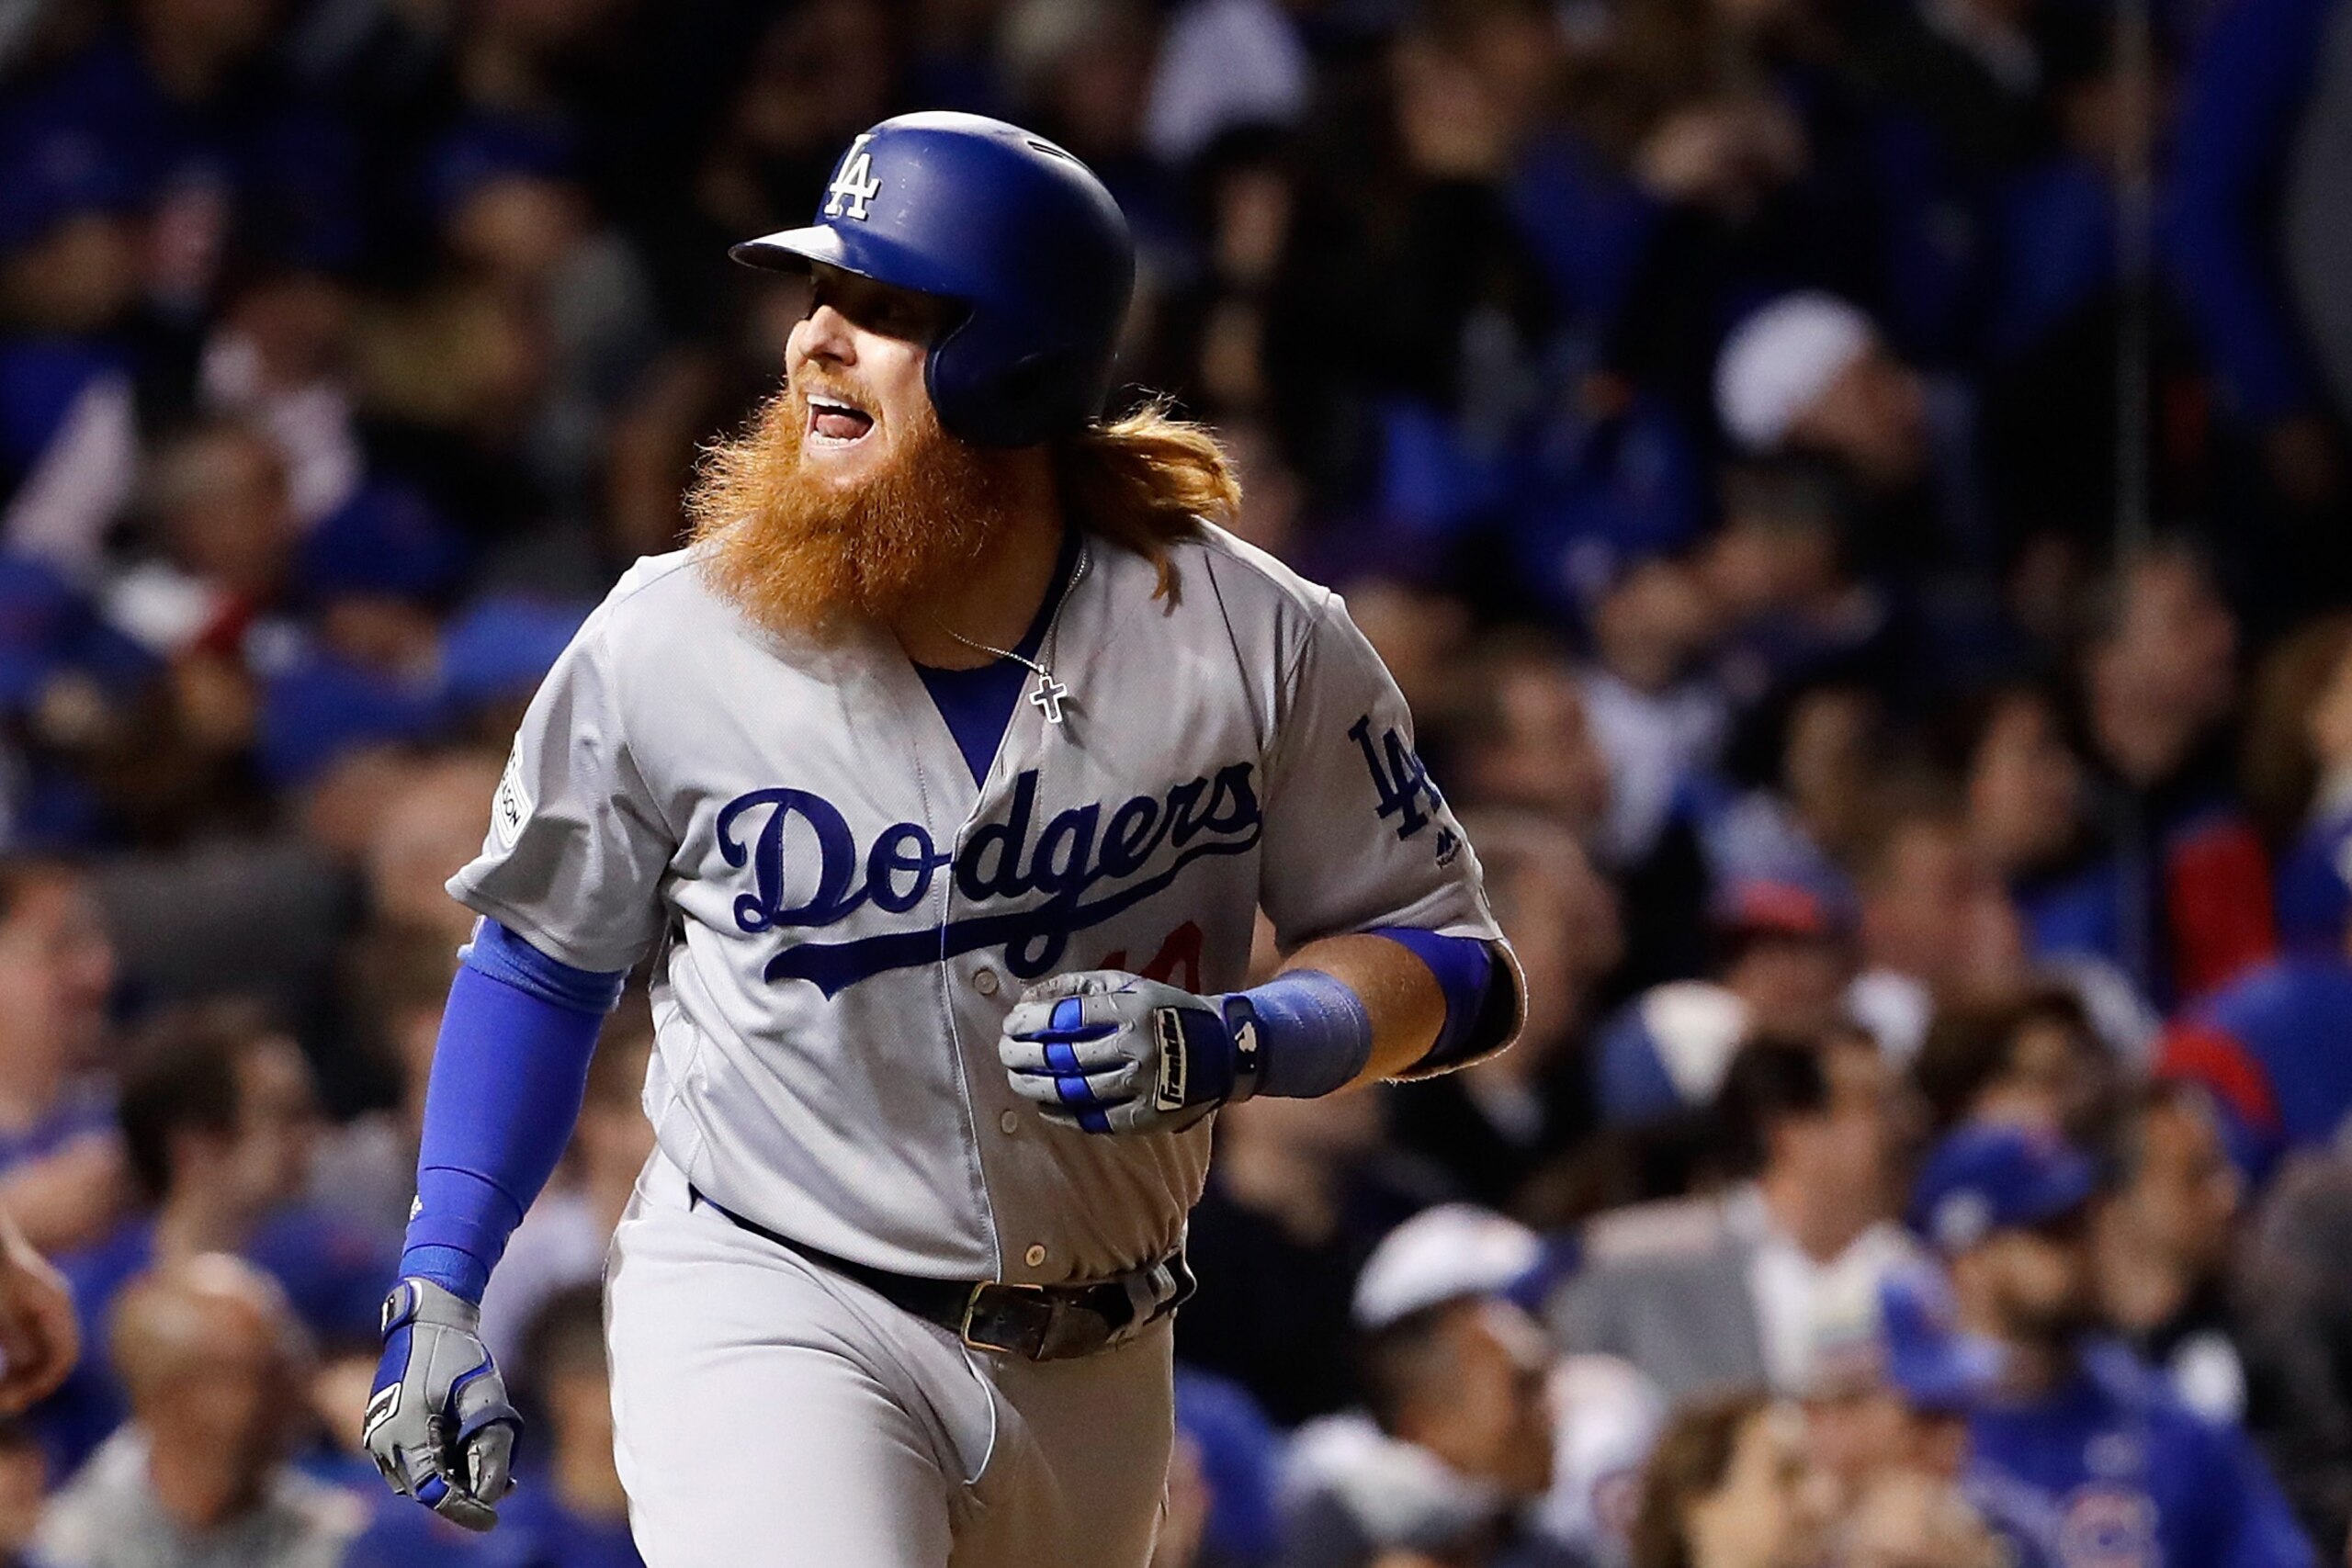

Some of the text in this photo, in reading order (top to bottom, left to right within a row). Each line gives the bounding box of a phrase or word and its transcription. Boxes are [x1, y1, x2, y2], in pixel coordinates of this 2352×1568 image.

[824, 133, 882, 221] LA
[1348, 713, 1442, 841] LA
[717, 761, 1262, 979] Dodgers
